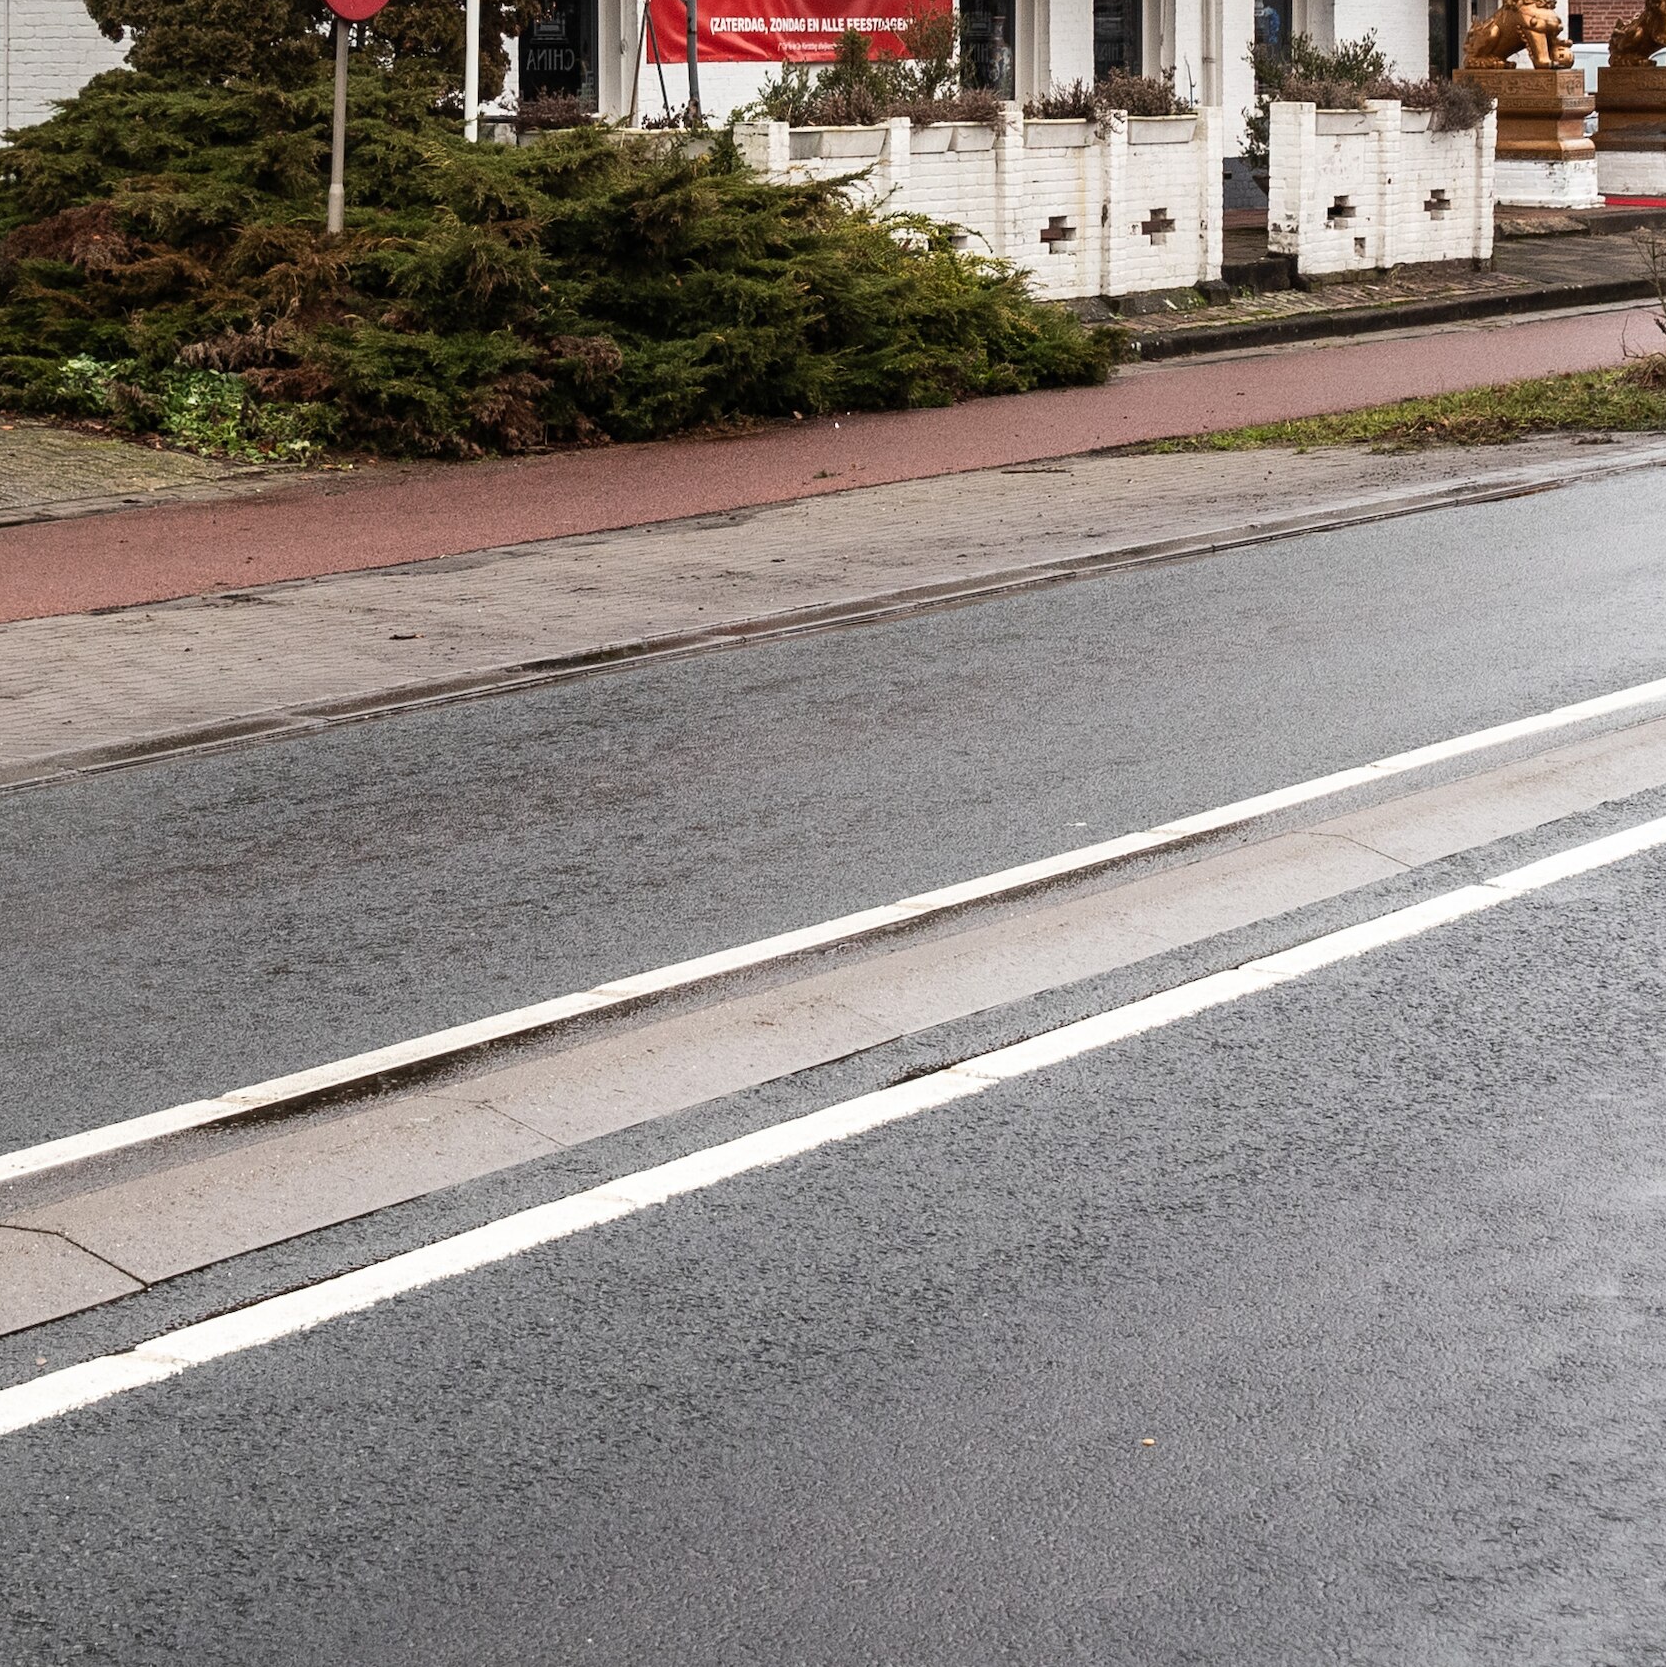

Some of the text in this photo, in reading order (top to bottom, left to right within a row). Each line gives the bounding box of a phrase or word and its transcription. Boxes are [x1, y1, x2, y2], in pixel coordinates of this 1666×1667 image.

[709, 17, 768, 35] (ZATERDAG,
[769, 17, 806, 33] ZONDAG
[807, 17, 820, 32] EN
[821, 17, 845, 32] ALLE
